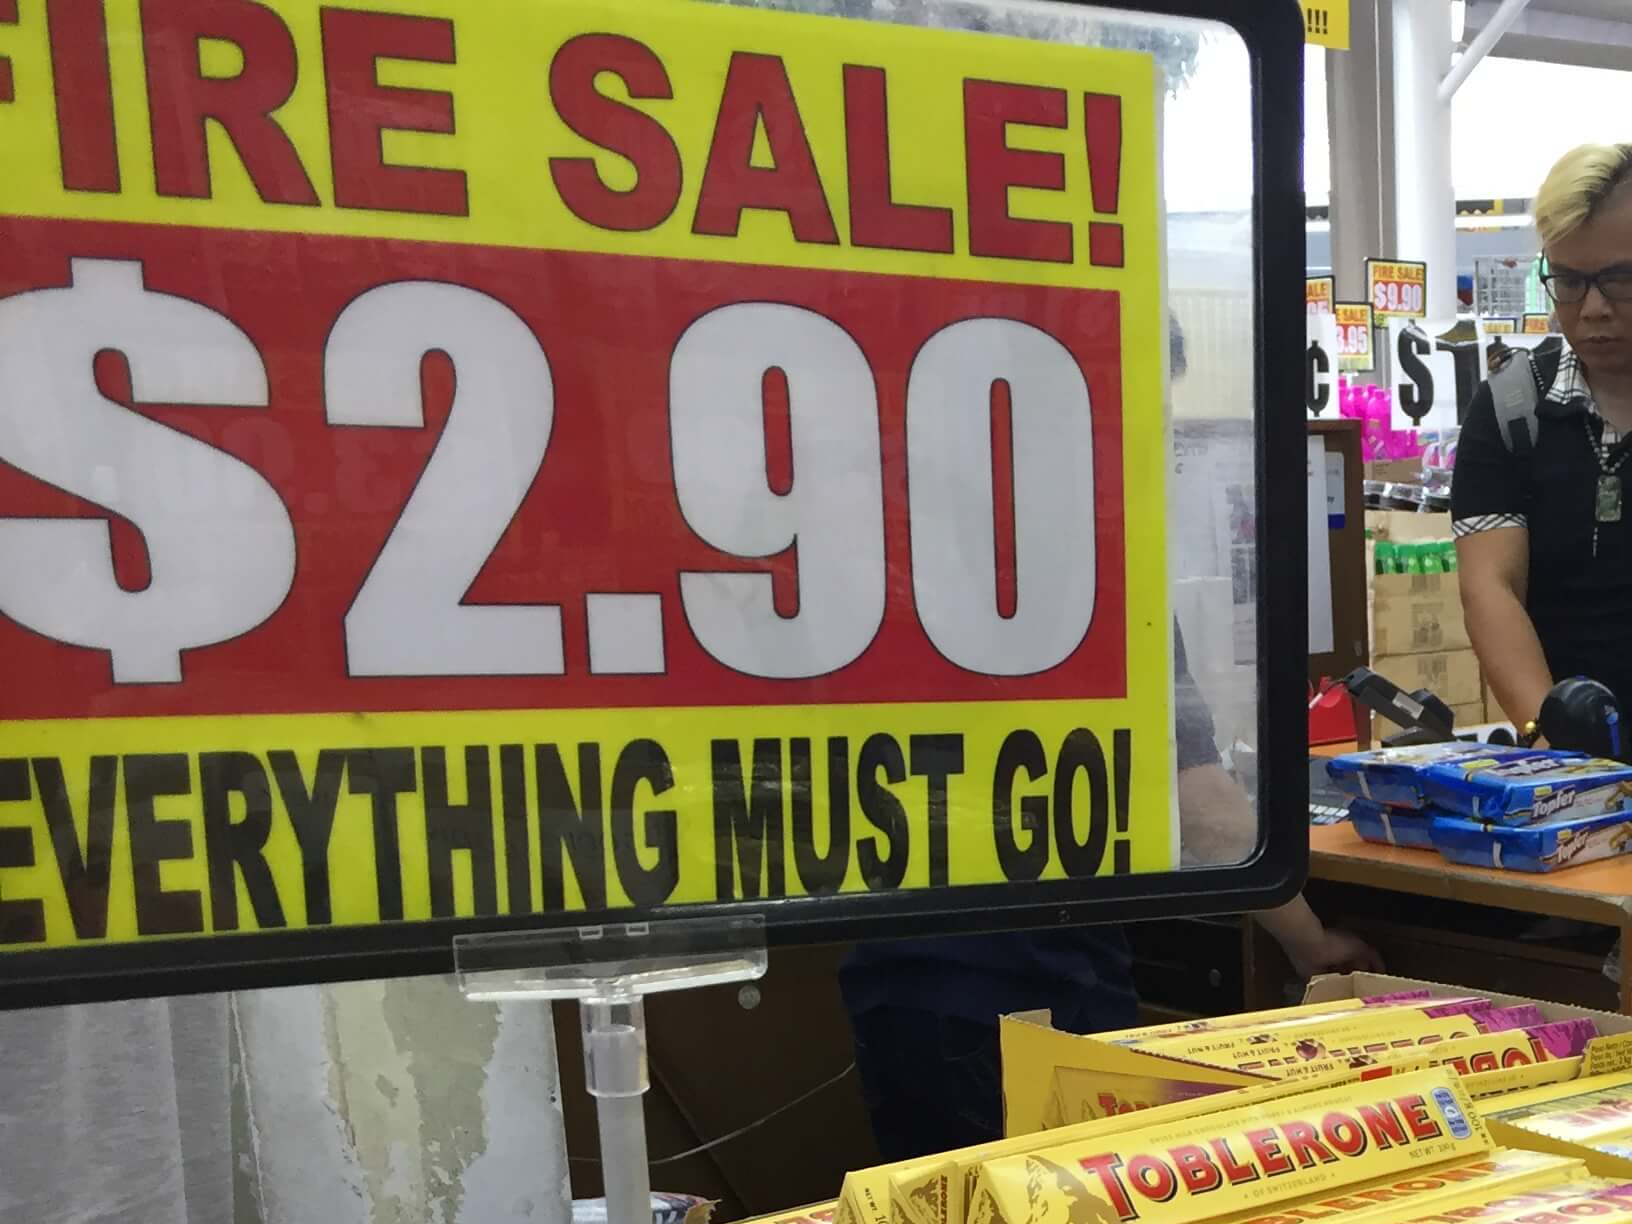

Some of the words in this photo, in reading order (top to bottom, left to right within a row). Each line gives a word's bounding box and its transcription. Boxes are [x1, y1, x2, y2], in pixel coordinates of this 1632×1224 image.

[0, 0, 470, 217] IRE
[548, 30, 1124, 269] SALE!
[0, 257, 1096, 685] $2.90
[0, 736, 679, 945] EVERYTHING
[711, 732, 965, 904] MUST
[996, 728, 1132, 882] GO!
